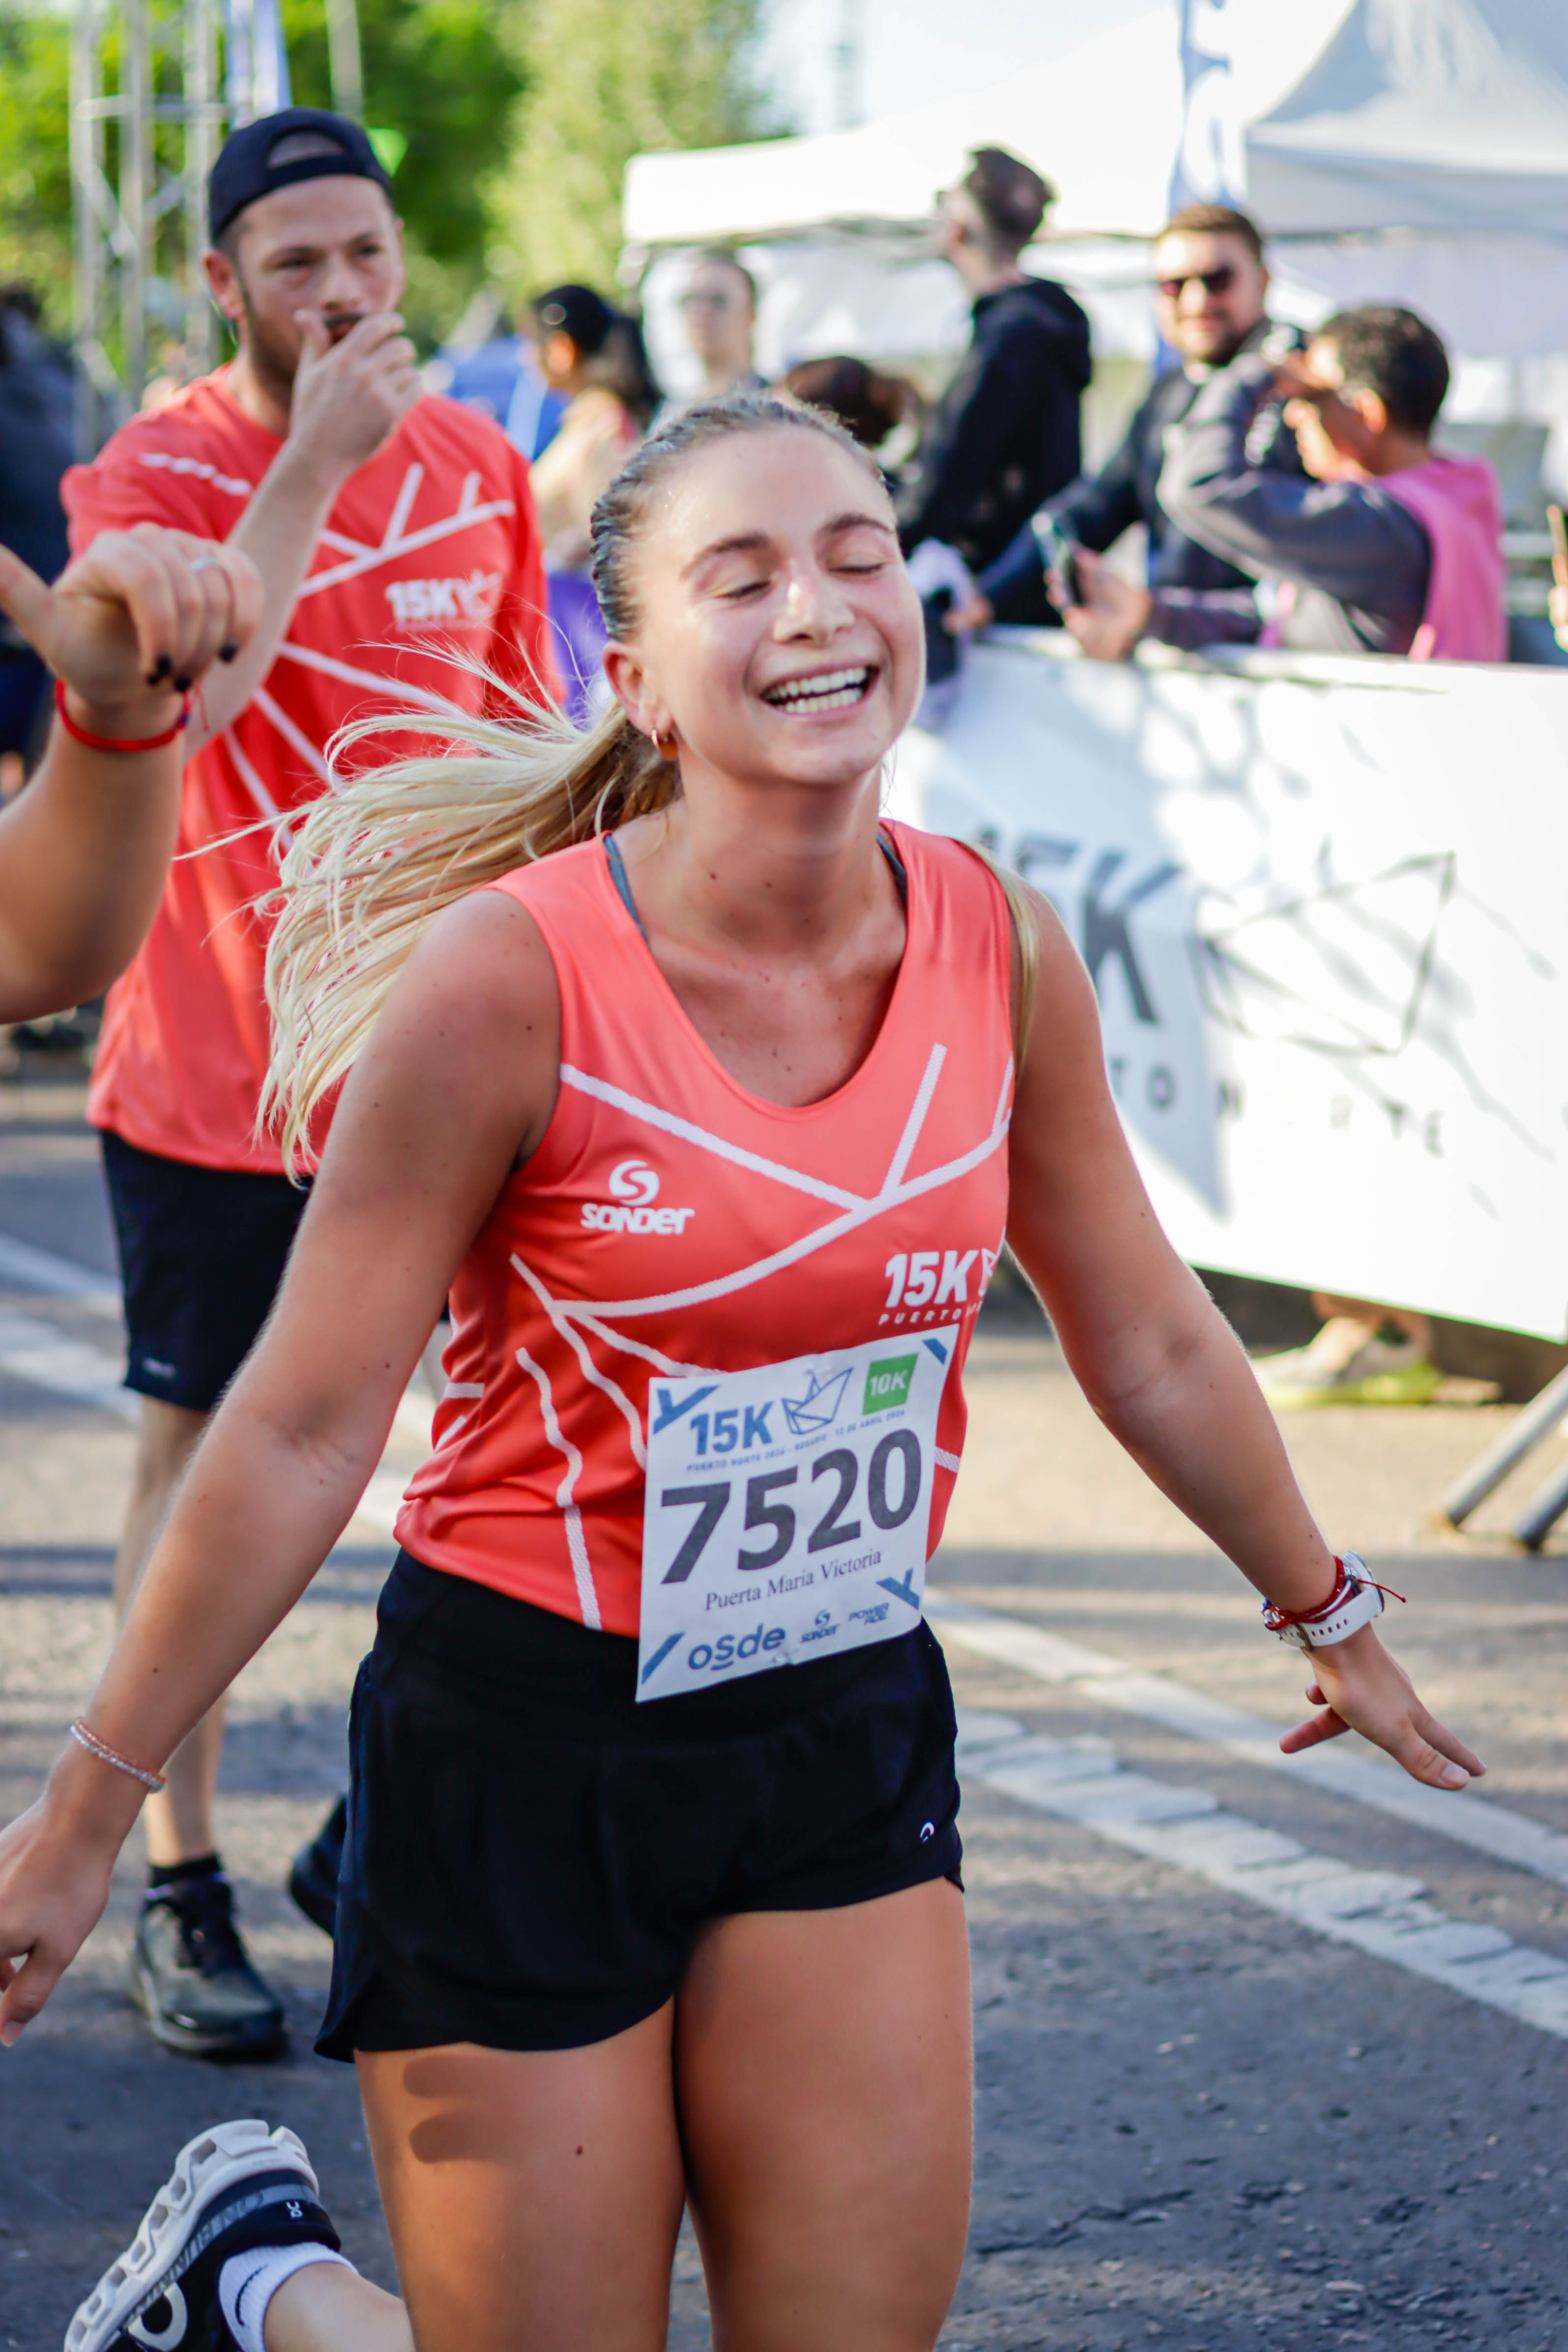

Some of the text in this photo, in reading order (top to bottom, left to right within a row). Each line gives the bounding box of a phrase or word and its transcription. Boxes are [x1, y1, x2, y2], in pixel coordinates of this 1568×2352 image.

[885, 1250, 979, 1308] 15K
[878, 1308, 962, 1326] PUERTO
[869, 1369, 909, 1397] 10K
[689, 1401, 774, 1456] 15K
[661, 1428, 922, 1585] 7520
[706, 1548, 882, 1611] Puerta Maria Victoria
[688, 1622, 786, 1670] osde
